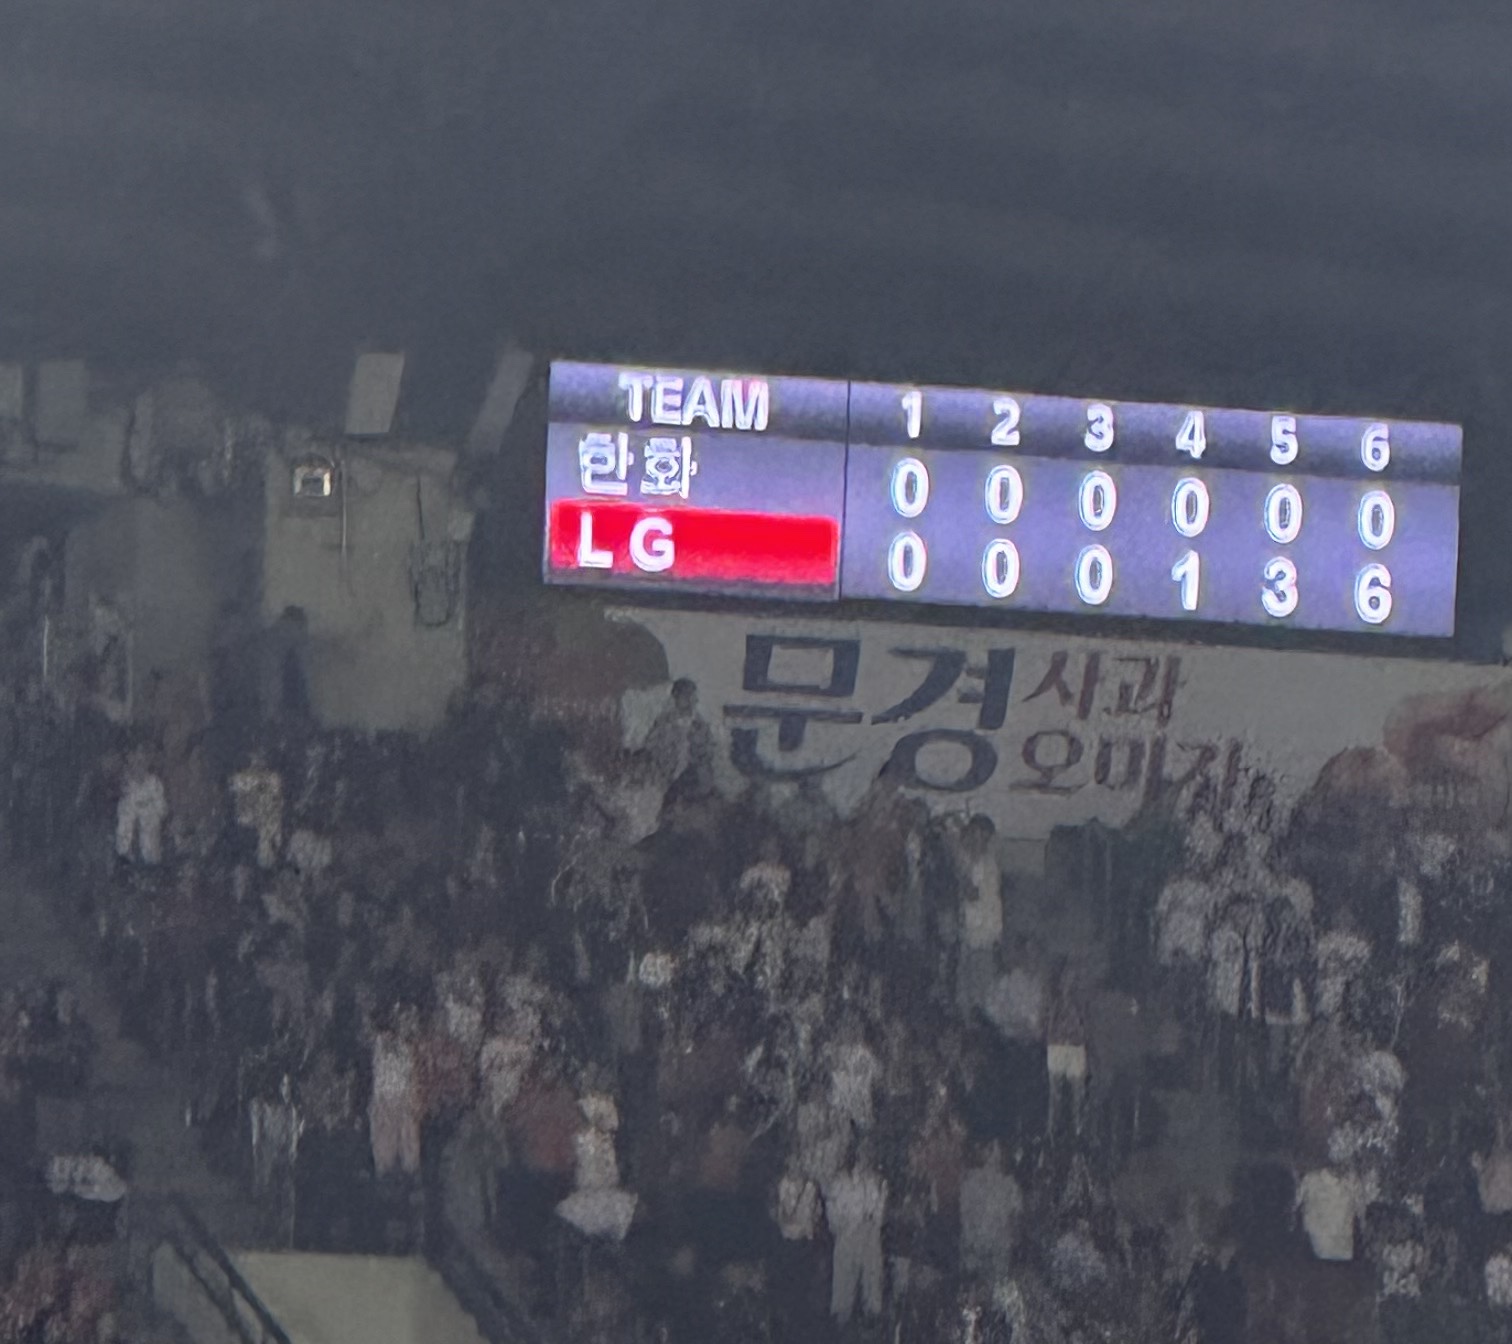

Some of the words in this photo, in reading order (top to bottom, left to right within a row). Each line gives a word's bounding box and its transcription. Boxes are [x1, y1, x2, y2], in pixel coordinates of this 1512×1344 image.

[618, 370, 769, 431] TEAM
[901, 391, 923, 439] 1
[990, 397, 1021, 446] 2
[1083, 403, 1114, 452] 3
[1175, 410, 1207, 459] 4
[1270, 415, 1298, 465] 5
[1360, 422, 1390, 471] 6
[577, 432, 698, 499] 한화
[890, 457, 930, 518] 0
[984, 464, 1023, 524] 0
[1078, 470, 1117, 531] 0
[1171, 476, 1210, 537] 0
[1263, 483, 1303, 544] 0
[1357, 490, 1395, 550] 0
[887, 530, 927, 592] 0
[981, 538, 1020, 599] 0
[1074, 543, 1113, 605] 0
[1171, 549, 1200, 611] 1
[1261, 556, 1299, 618] 3
[1353, 563, 1392, 624] 6
[723, 632, 1016, 793] 문경
[1022, 650, 1184, 728] 사과
